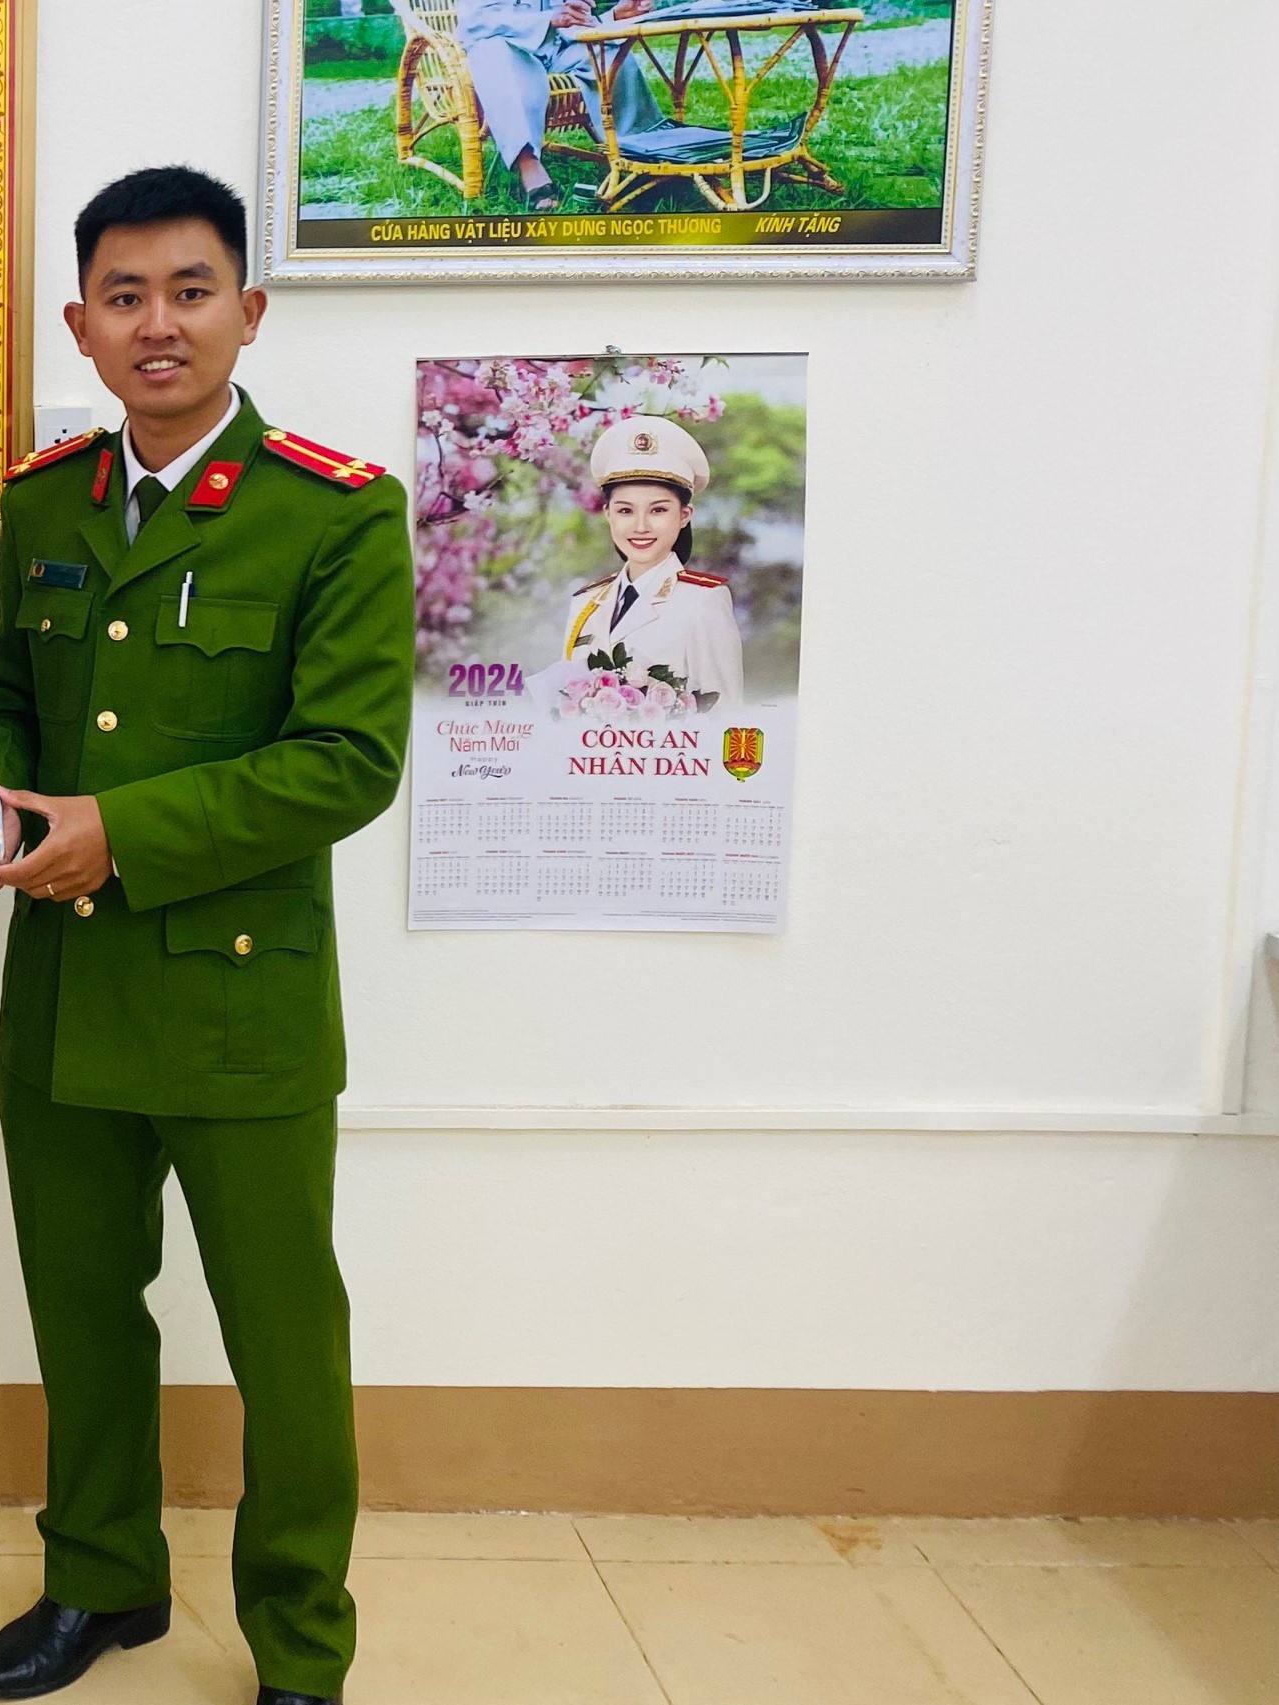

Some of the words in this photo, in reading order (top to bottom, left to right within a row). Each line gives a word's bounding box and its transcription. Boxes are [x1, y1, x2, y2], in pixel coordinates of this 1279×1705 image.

[371, 219, 403, 241] CỬA
[407, 219, 451, 241] HÀNG
[454, 219, 486, 244] VẬT
[489, 218, 522, 242] LIỆU
[525, 218, 558, 238] XÂY
[562, 219, 607, 241] DỰNG
[610, 218, 654, 240] NGỌC
[658, 217, 721, 234] THƯƠNG
[755, 212, 793, 233] KÍNH
[797, 212, 842, 238] TẶNG
[448, 663, 524, 697] 2024
[450, 737, 486, 752] Năm
[491, 736, 520, 752] Mới
[582, 724, 656, 749] CÔNG
[660, 729, 701, 749] AN
[451, 764, 478, 778] New
[479, 764, 512, 780] Year
[568, 751, 647, 775] NHÂN
[653, 752, 711, 776] DÂN
